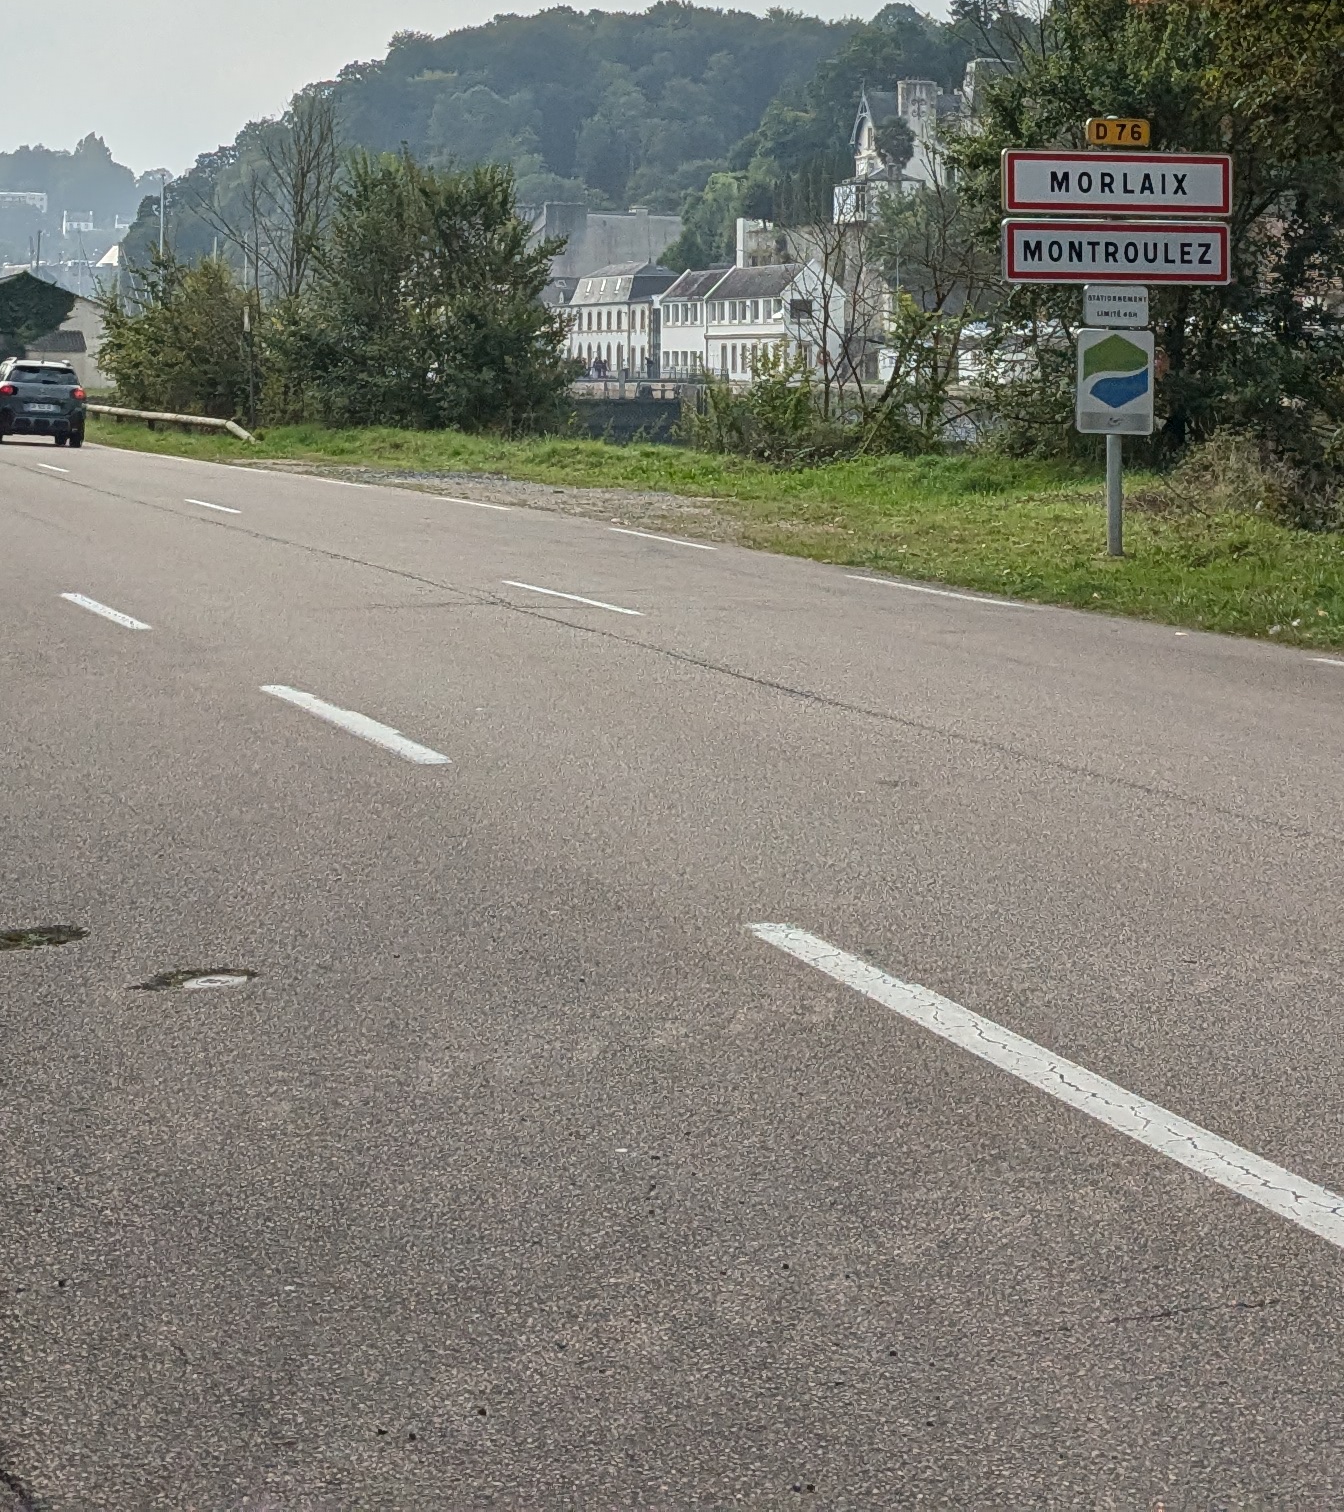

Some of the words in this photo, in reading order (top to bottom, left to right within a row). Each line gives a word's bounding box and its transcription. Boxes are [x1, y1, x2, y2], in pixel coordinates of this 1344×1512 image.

[1096, 123, 1107, 139] D
[1116, 124, 1141, 141] 76
[1050, 171, 1187, 195] MORLAIX
[1023, 240, 1212, 264] MONTROULEZ
